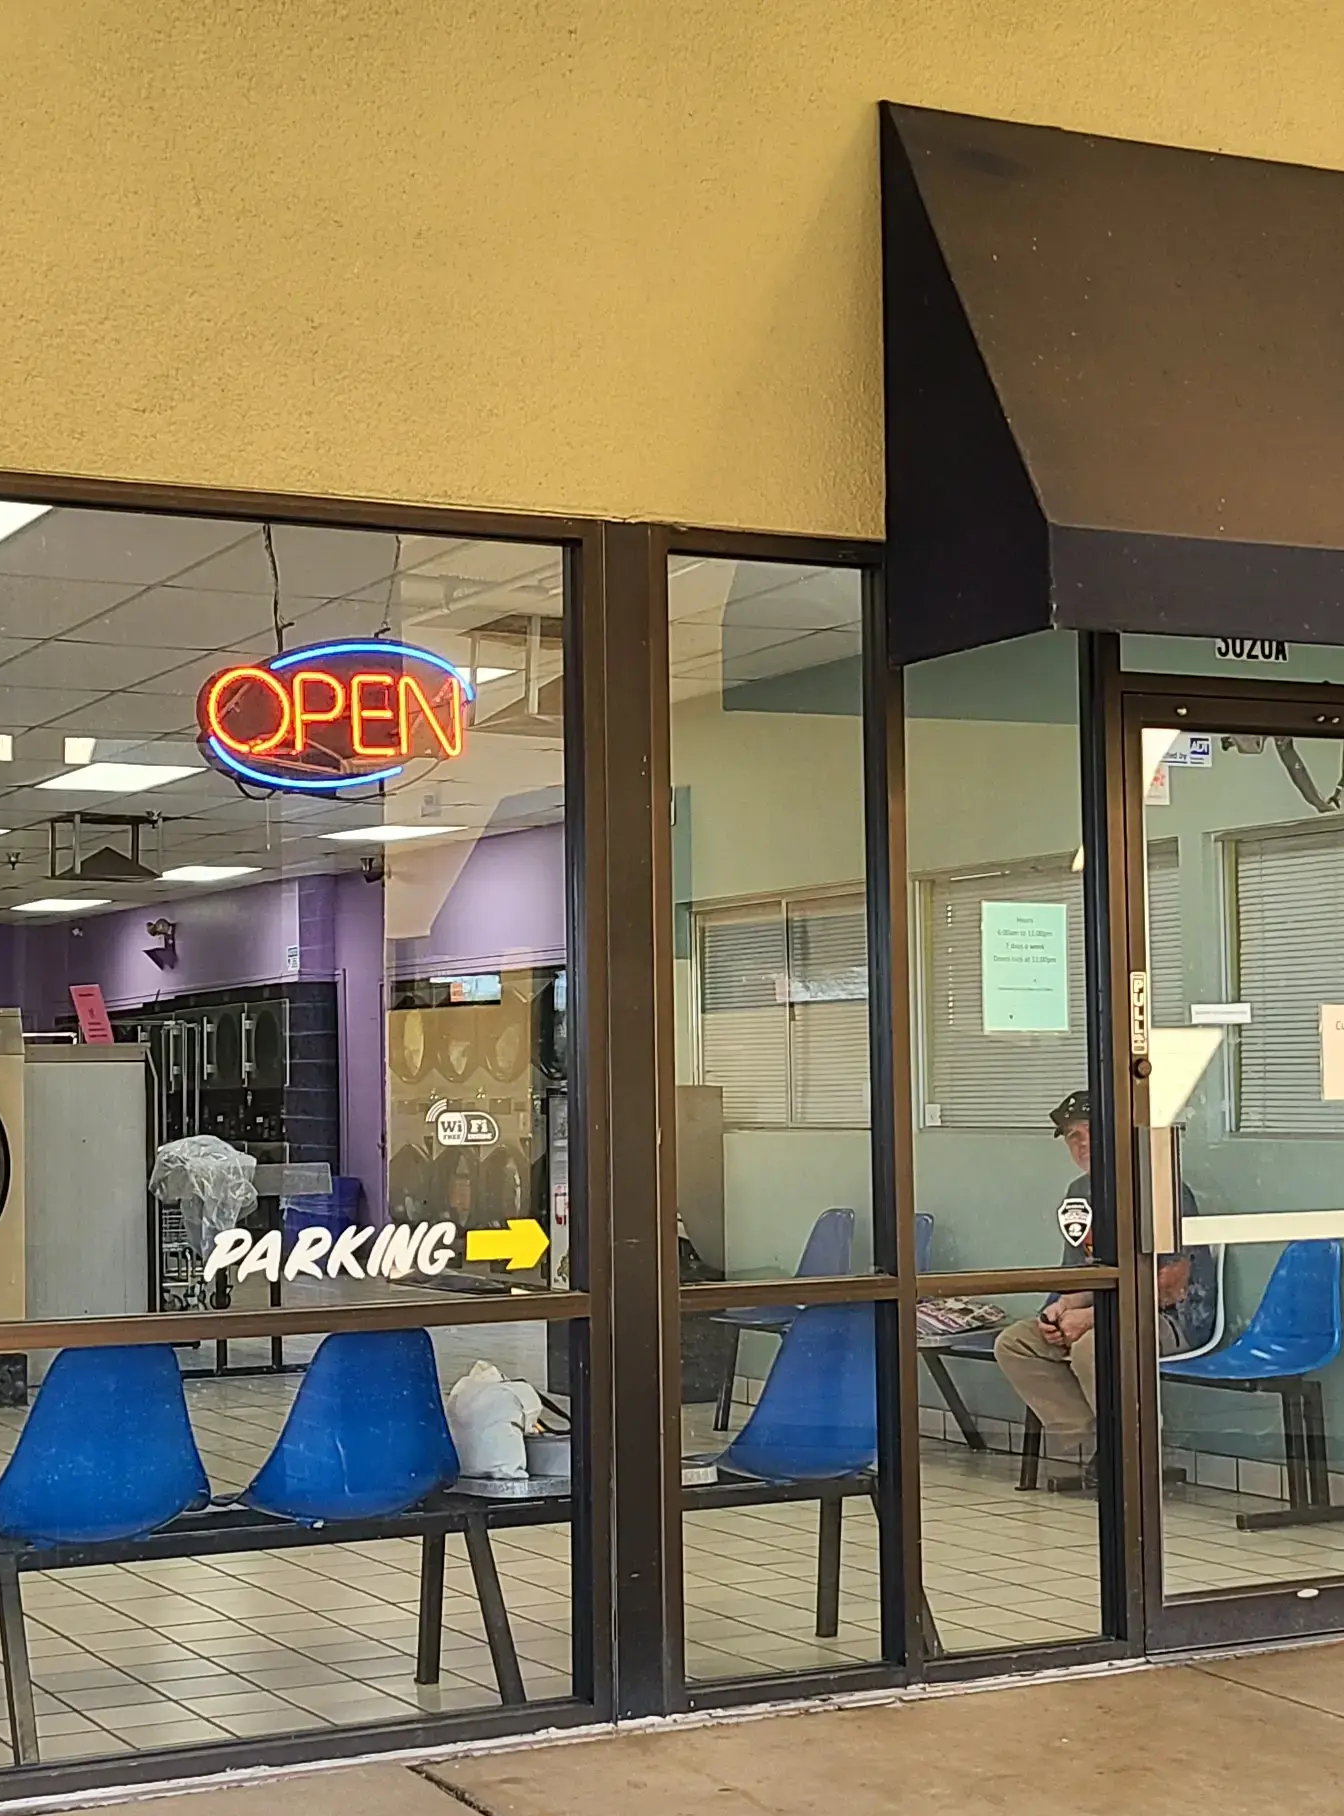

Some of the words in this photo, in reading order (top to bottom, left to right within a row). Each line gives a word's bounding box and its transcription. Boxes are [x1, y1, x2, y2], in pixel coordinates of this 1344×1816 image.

[207, 666, 464, 758] OPEN
[1190, 740, 1209, 753] ADT
[1133, 979, 1145, 1034] PULL
[440, 1120, 463, 1133] Wi
[471, 1119, 488, 1133] Fi
[203, 1221, 457, 1283] PARKING
